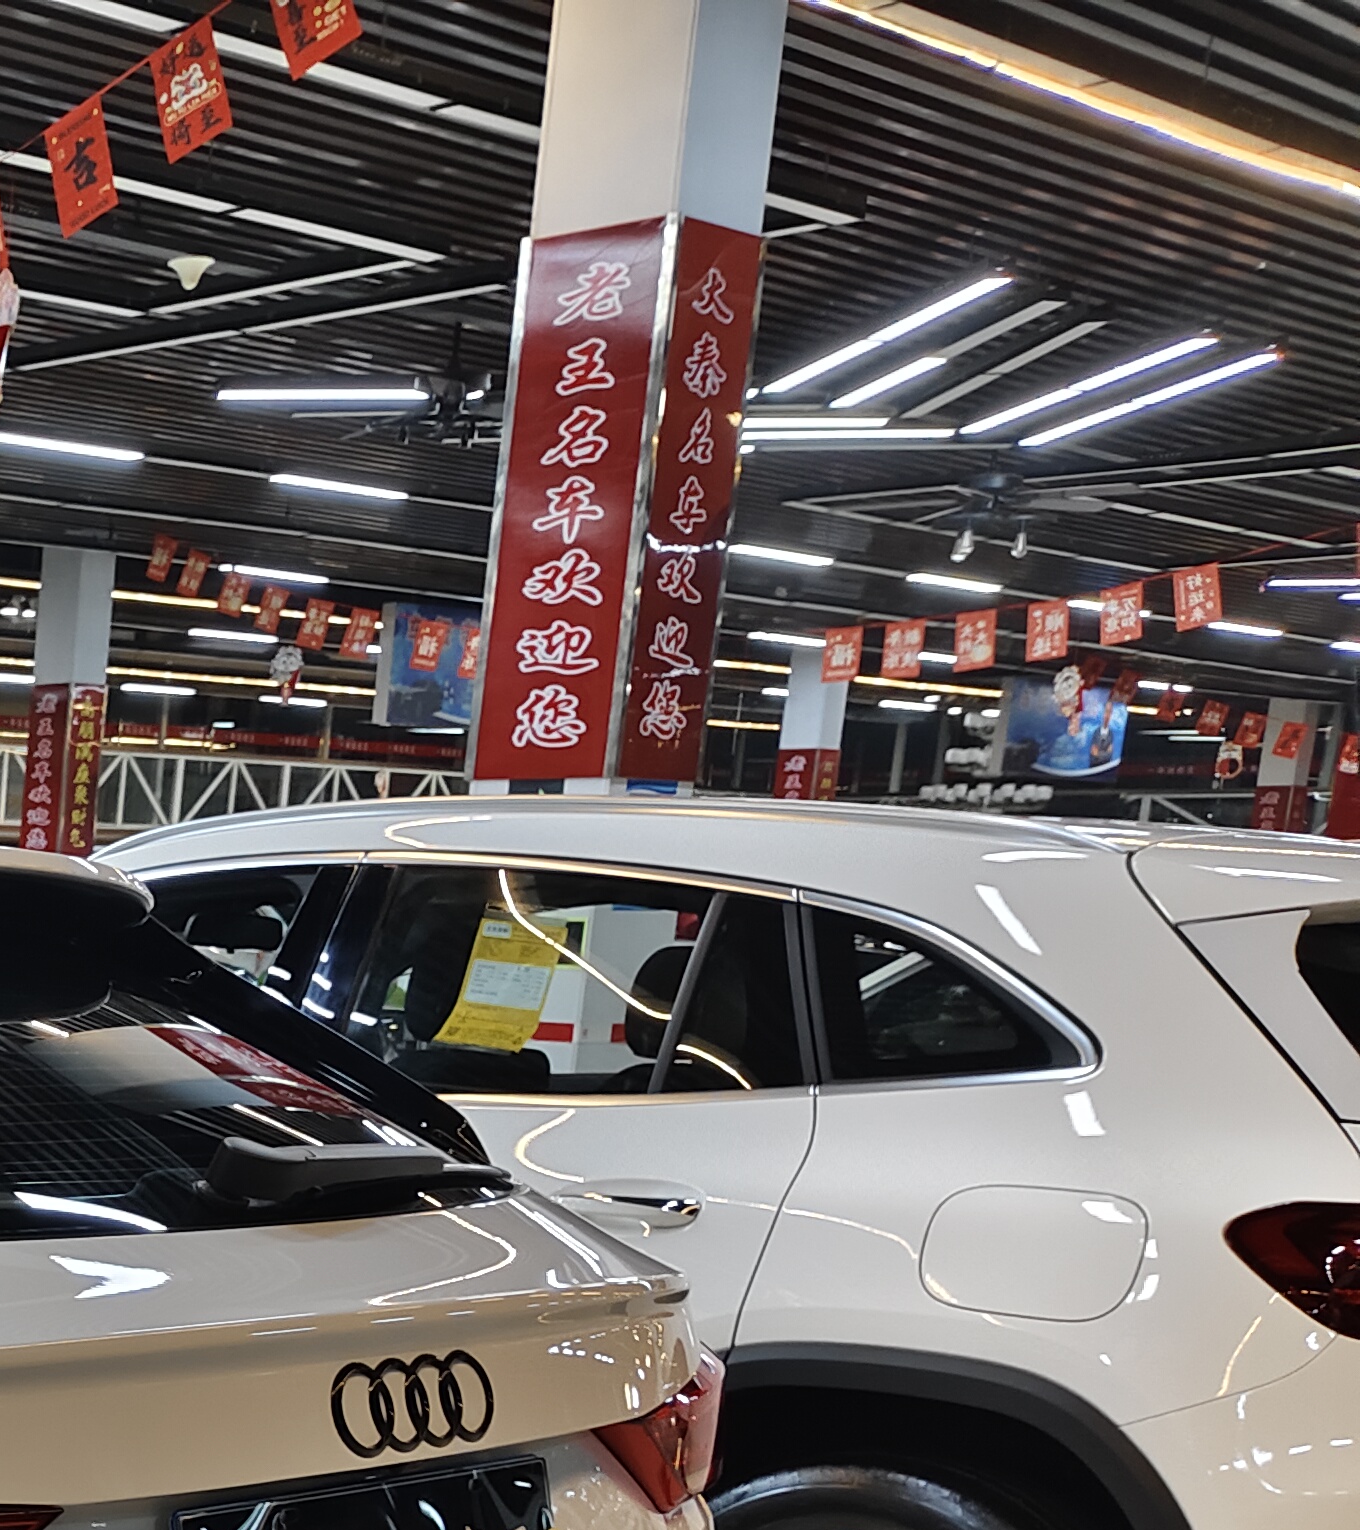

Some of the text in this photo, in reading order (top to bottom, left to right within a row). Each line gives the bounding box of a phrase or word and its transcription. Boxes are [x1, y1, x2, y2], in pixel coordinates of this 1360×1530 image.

[511, 261, 630, 750] 老王名车欢迎您
[639, 266, 735, 741] 大秦名车欢迎您
